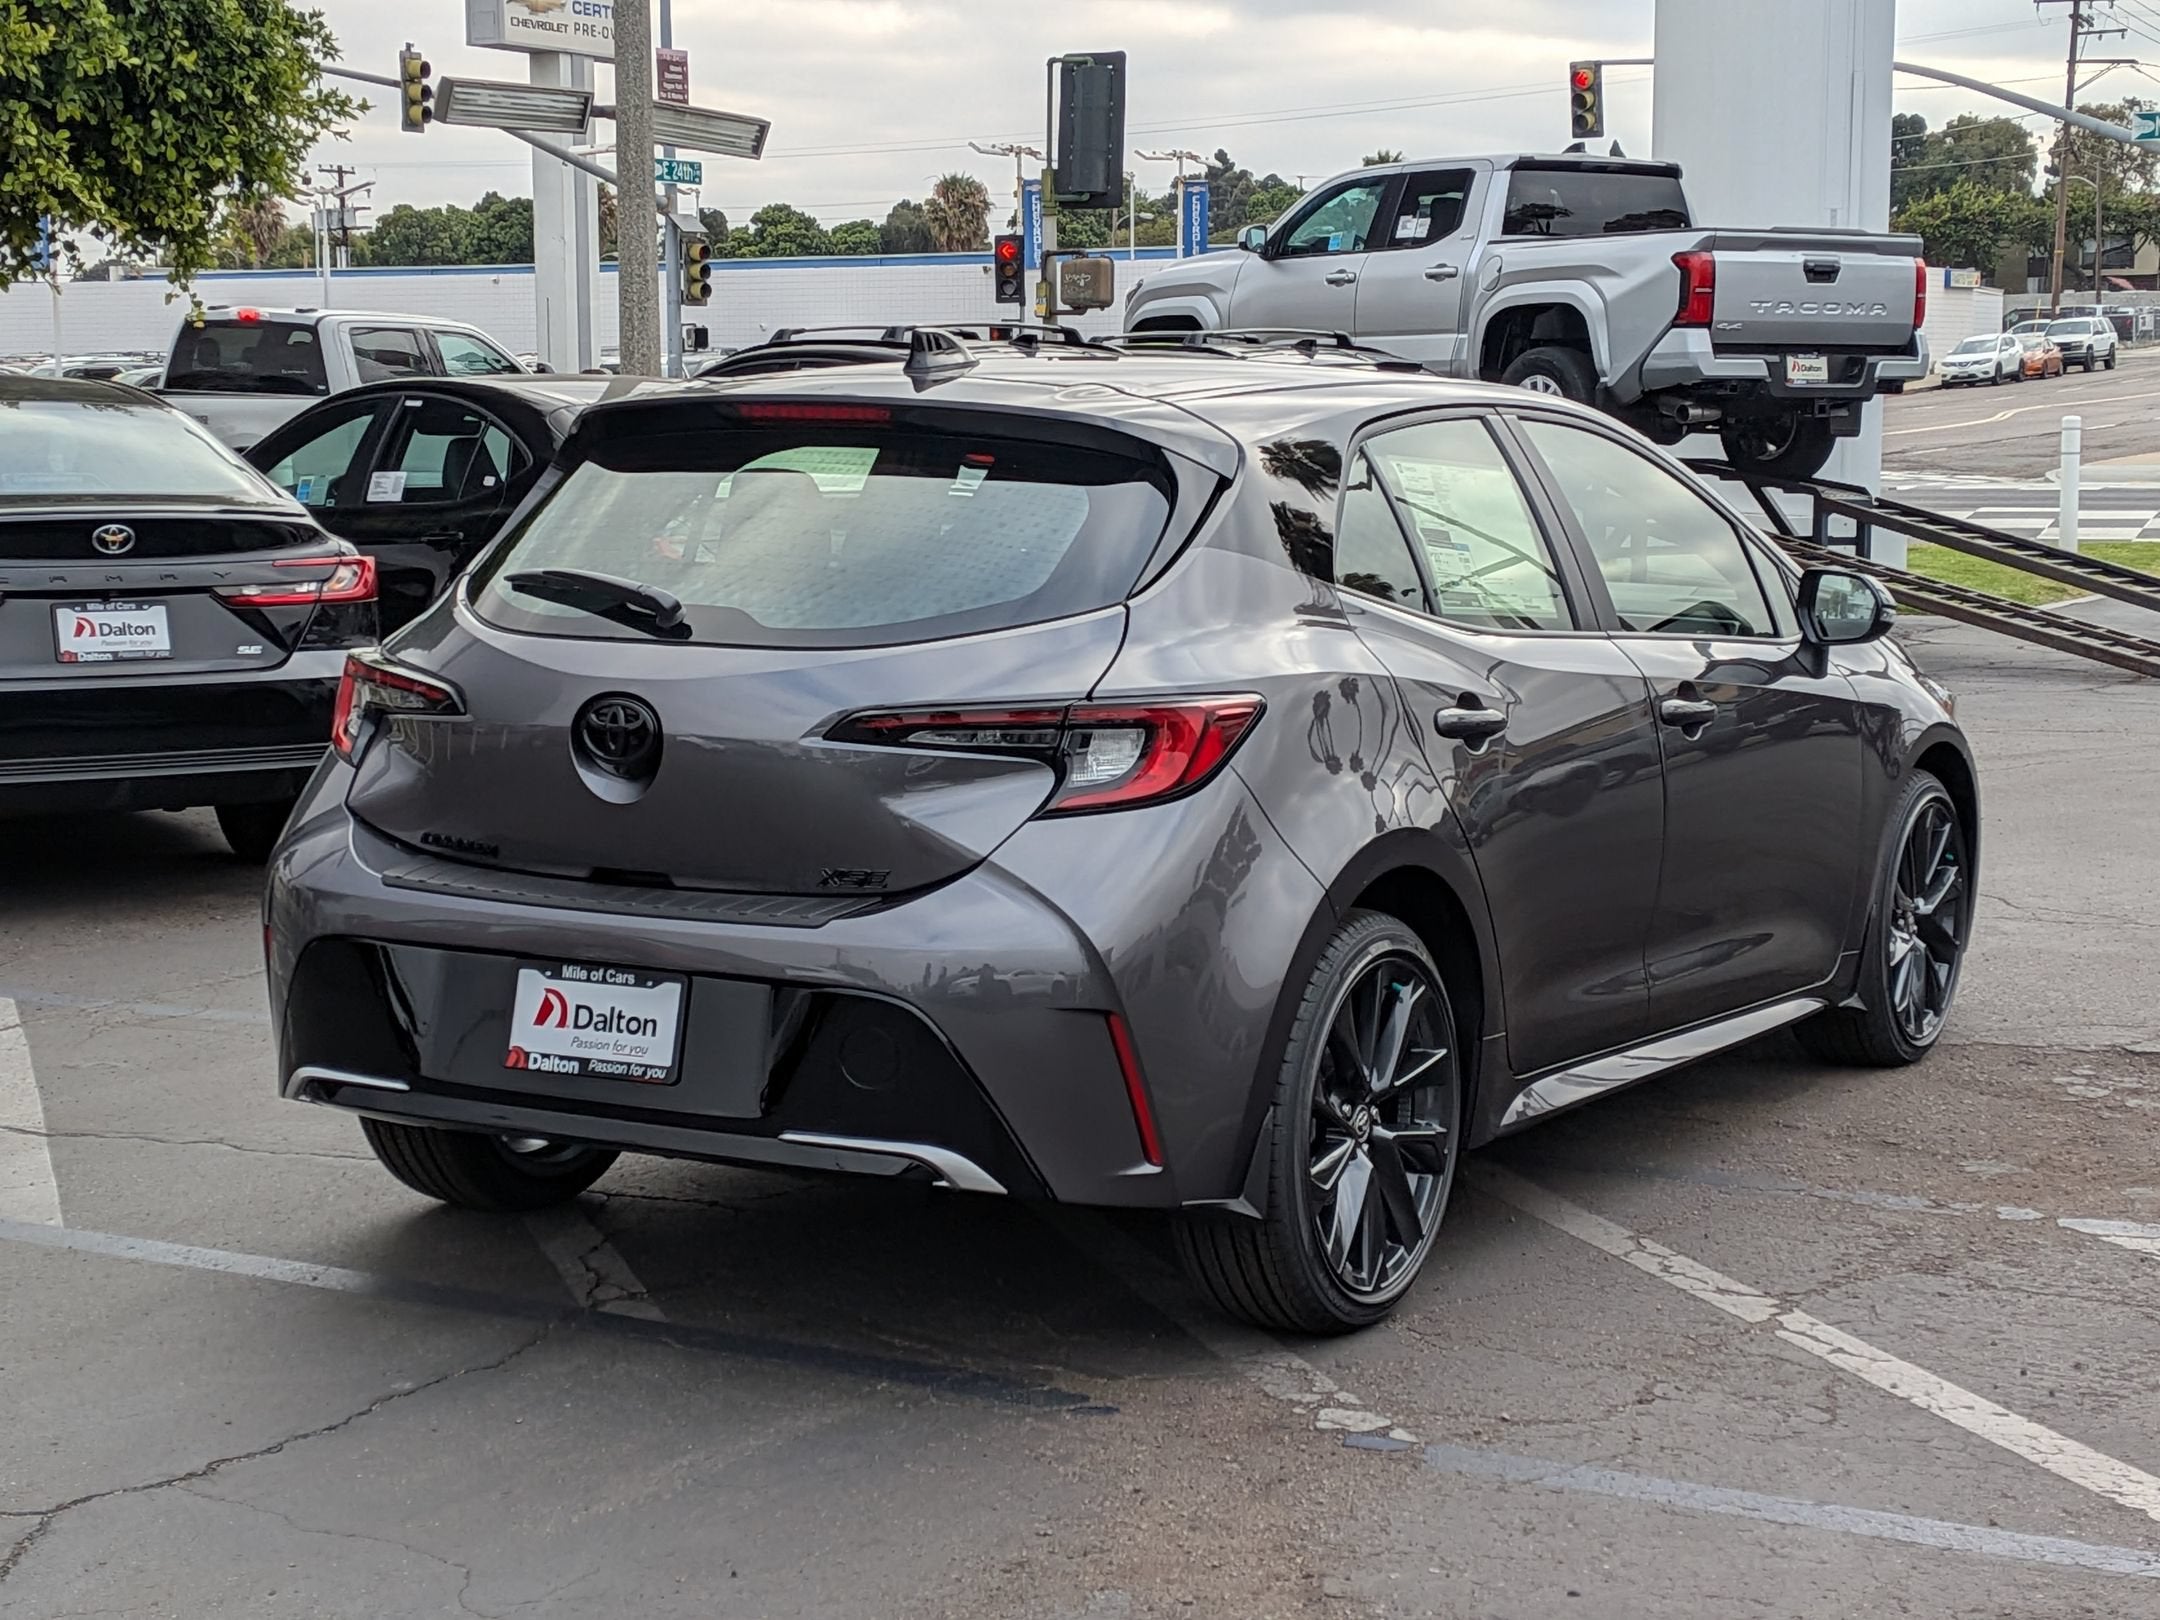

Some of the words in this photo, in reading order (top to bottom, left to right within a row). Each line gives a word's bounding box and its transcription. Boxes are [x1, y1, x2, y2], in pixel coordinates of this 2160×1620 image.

[510, 16, 569, 33] CHEVROLET
[663, 161, 671, 180] E
[671, 161, 693, 181] 24th
[1749, 301, 1888, 316] TACOMA
[98, 621, 156, 637] Dalton
[562, 965, 587, 981] Mile
[590, 968, 604, 982] of
[606, 970, 636, 985] Cars
[573, 1004, 657, 1037] Dalton
[570, 1036, 610, 1051] Passion
[612, 1040, 627, 1053] for
[629, 1043, 649, 1055] you
[528, 1053, 580, 1074] Dalton
[588, 1059, 627, 1076] Passion
[628, 1063, 645, 1079] for
[645, 1067, 668, 1080] you
